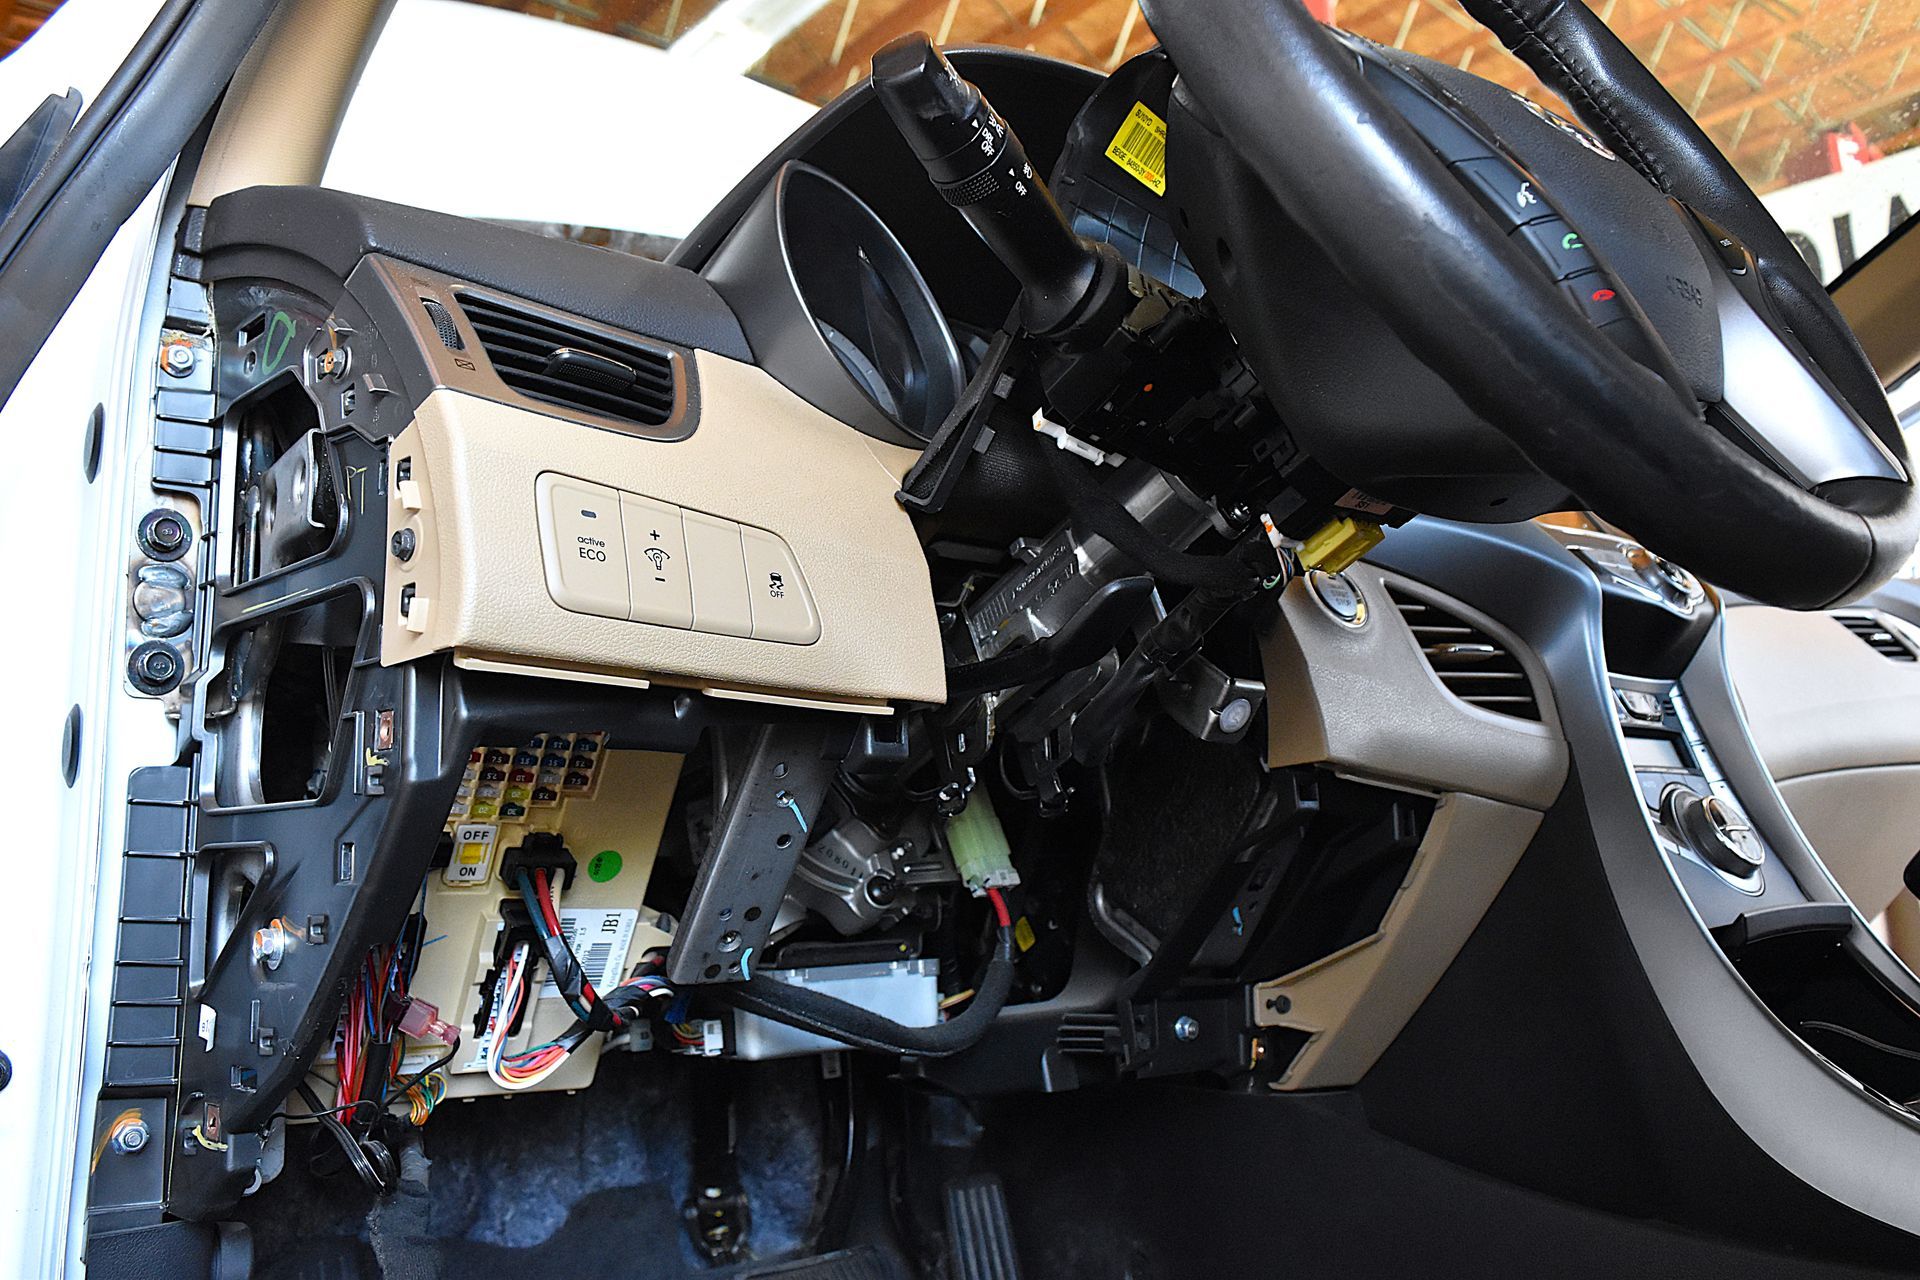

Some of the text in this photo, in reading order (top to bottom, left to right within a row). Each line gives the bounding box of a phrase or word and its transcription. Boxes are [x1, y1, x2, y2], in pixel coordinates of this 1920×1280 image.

[981, 127, 994, 146] DRL
[980, 140, 995, 157] OFF
[1112, 145, 1128, 161] BEIGE
[1015, 181, 1028, 197] OFF
[577, 535, 606, 548] active
[578, 547, 607, 563] ECO
[769, 589, 785, 599] OFF
[486, 772, 498, 780] 7.5
[538, 792, 550, 800] 7.5
[463, 831, 490, 841] OFF
[459, 866, 477, 877] ON
[601, 912, 622, 935] JB1
